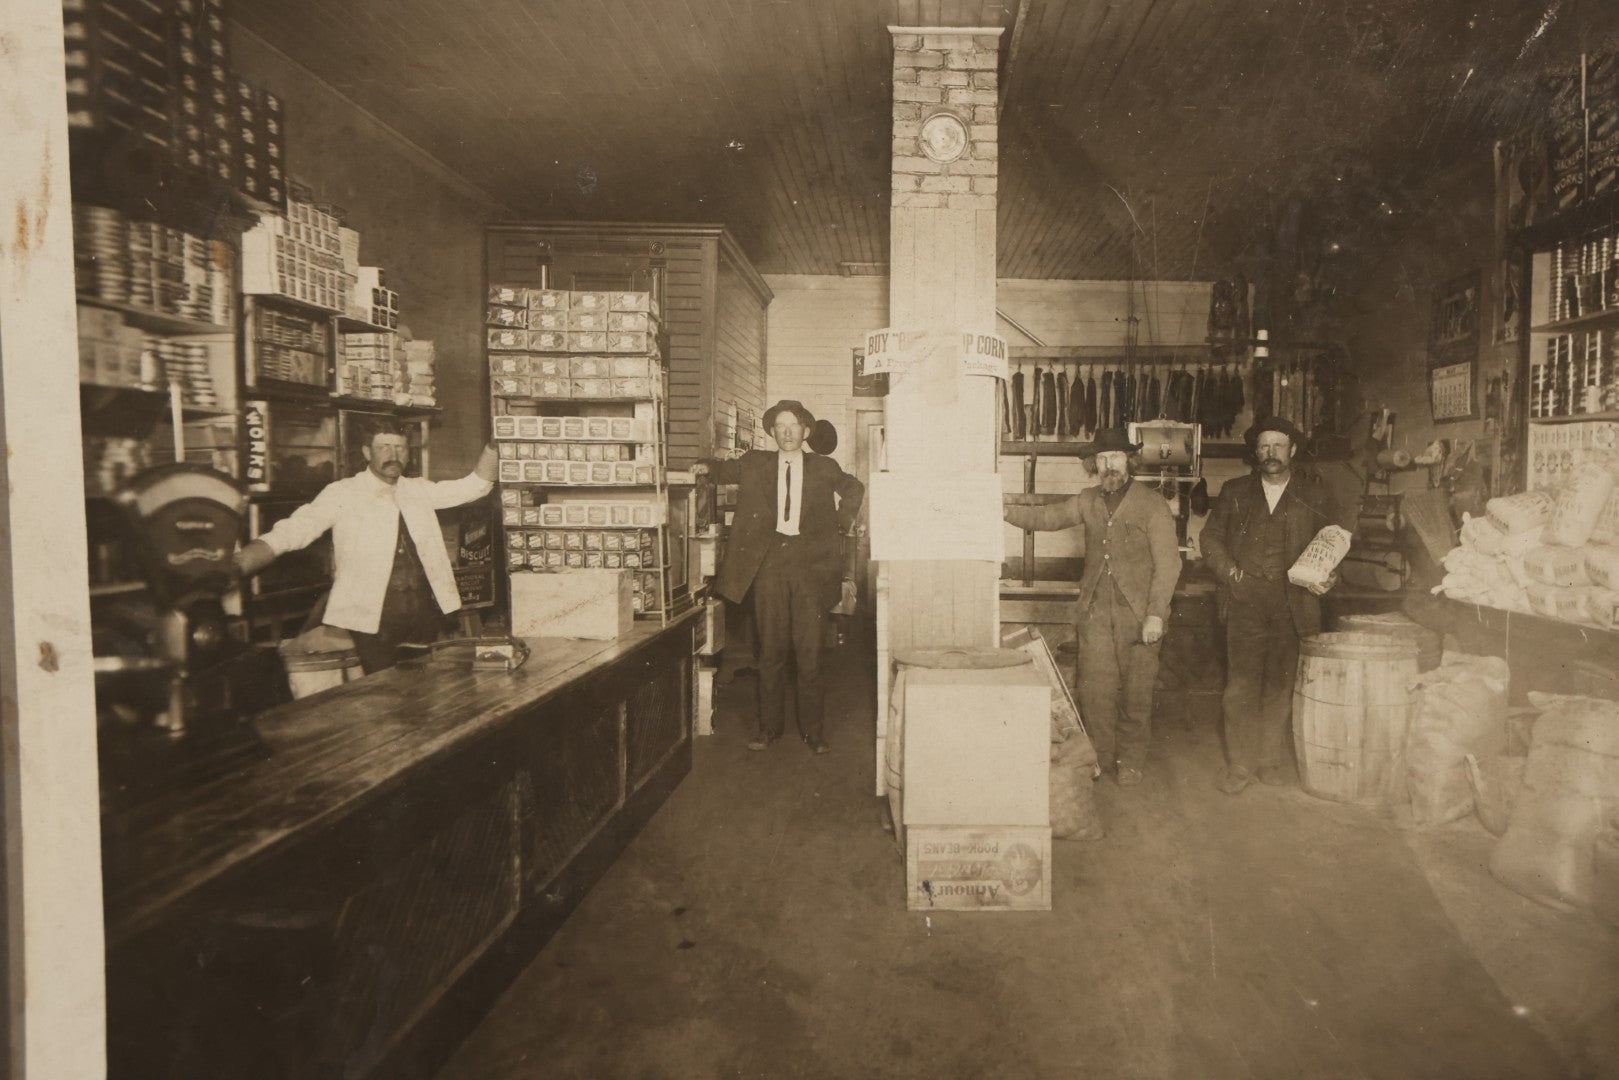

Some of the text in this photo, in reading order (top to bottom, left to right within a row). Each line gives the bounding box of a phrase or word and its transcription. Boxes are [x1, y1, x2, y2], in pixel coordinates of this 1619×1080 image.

[1553, 173, 1584, 194] WORKS
[868, 333, 888, 356] BUY
[977, 335, 1005, 361] CORN
[246, 410, 265, 479] WORKS
[460, 544, 490, 561] BISCUIT
[924, 842, 960, 855] BEANS
